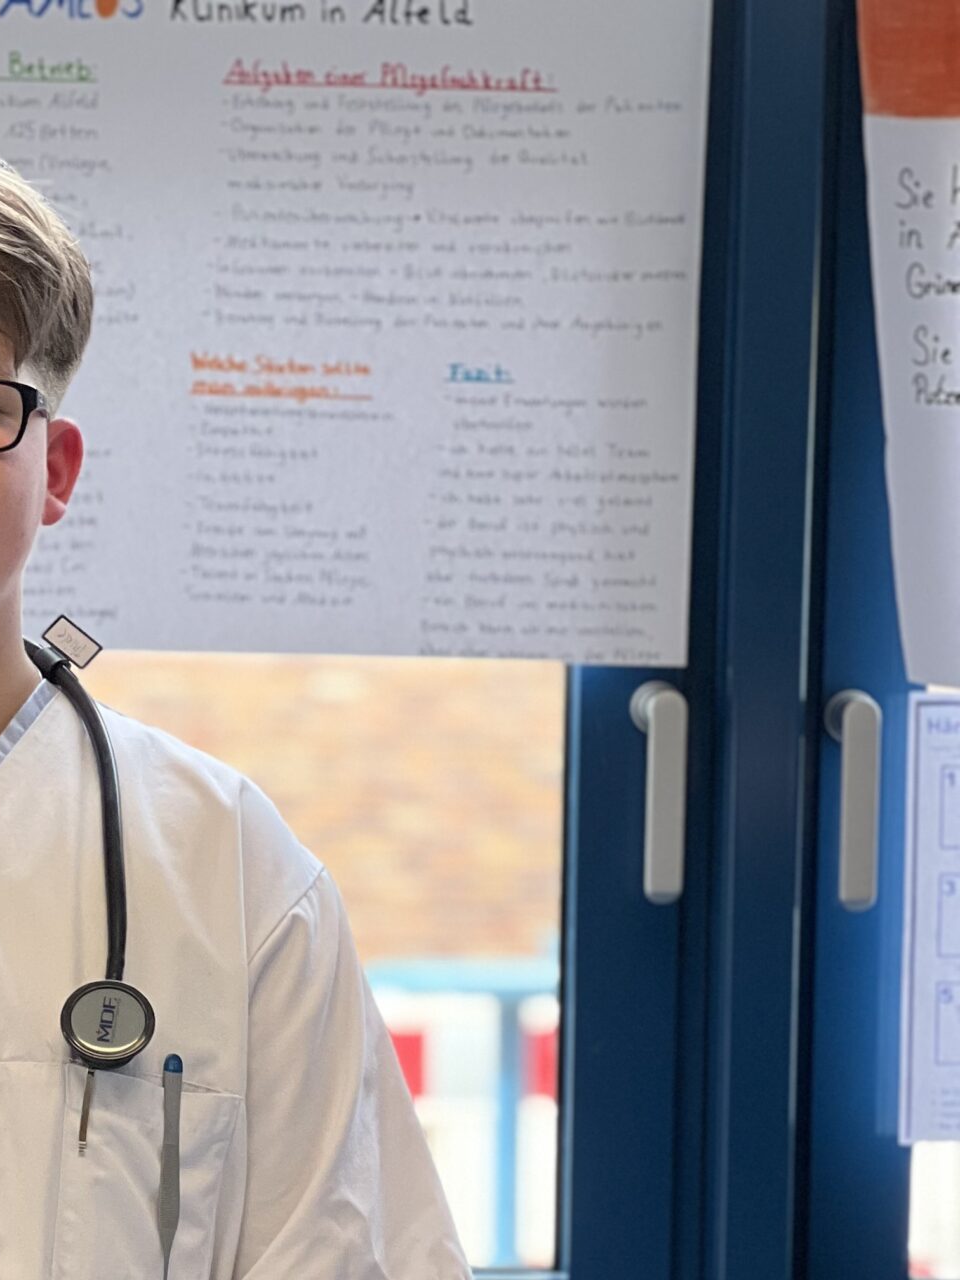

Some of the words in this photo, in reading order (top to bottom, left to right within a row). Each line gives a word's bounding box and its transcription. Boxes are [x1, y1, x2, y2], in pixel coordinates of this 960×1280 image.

[319, 1, 345, 22] in
[361, 0, 474, 26] Alfeld
[896, 166, 935, 210] Sie
[899, 218, 925, 250] in
[911, 324, 952, 368] Sie
[96, 996, 116, 1043] MDF
